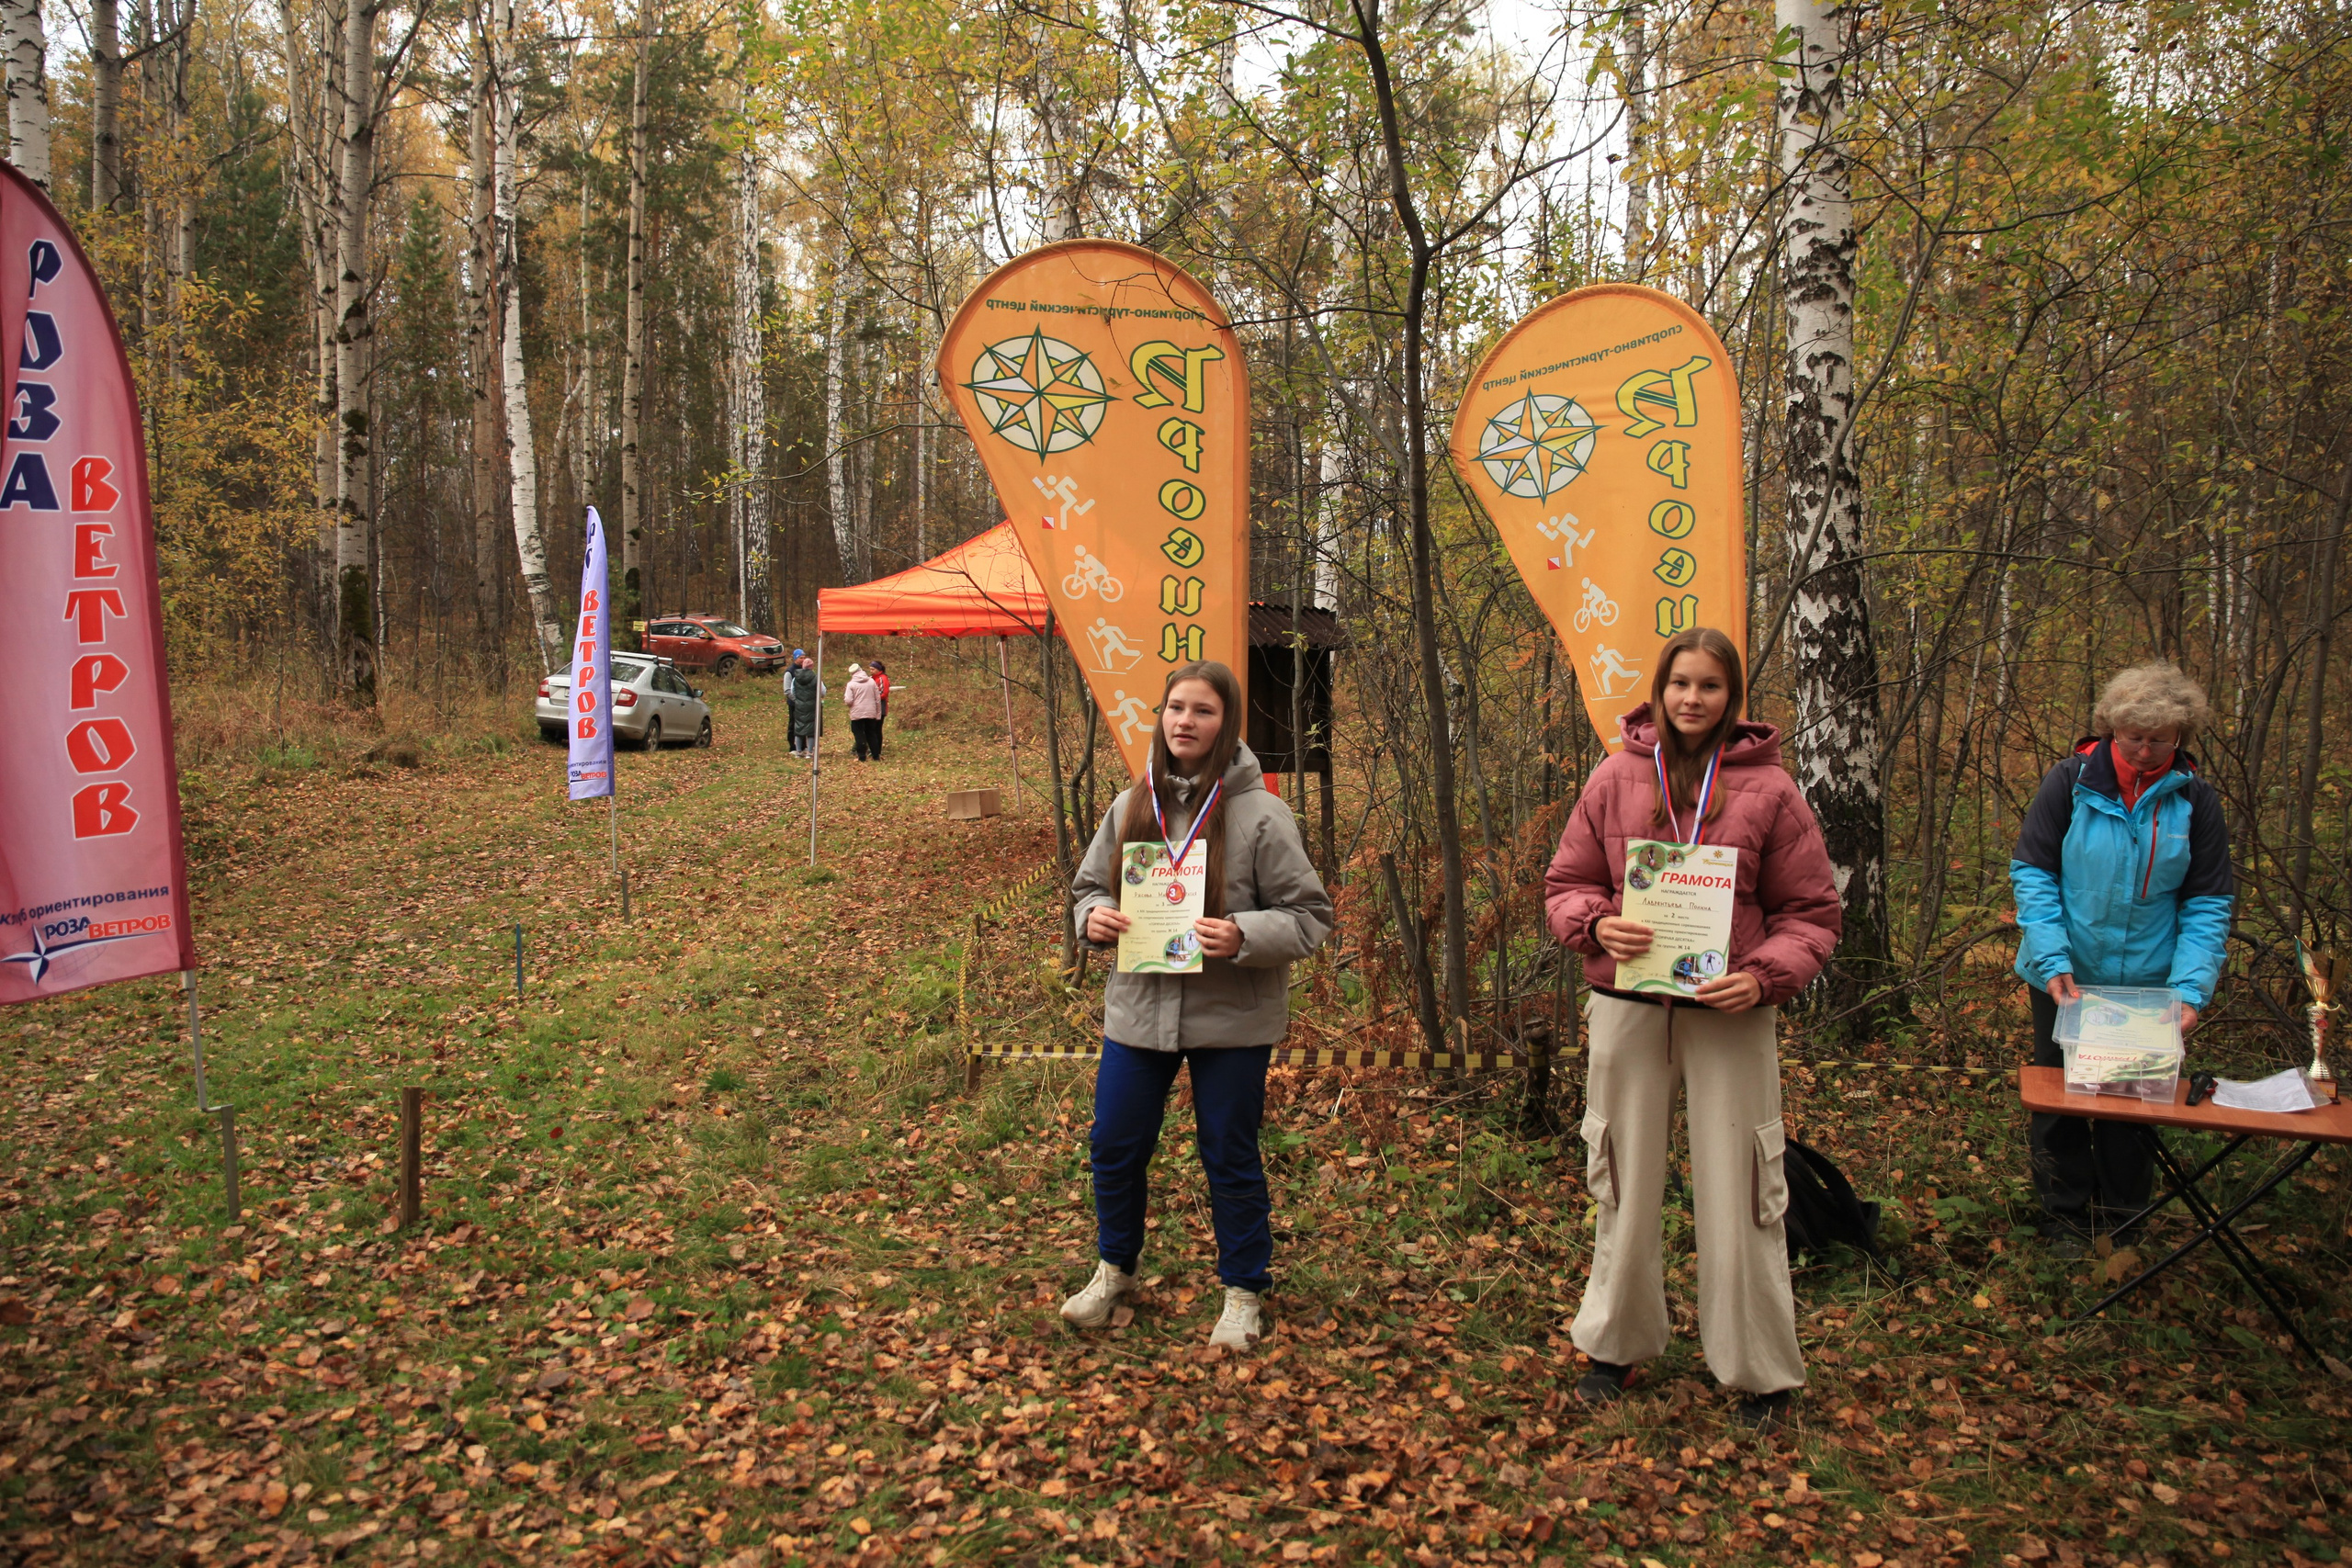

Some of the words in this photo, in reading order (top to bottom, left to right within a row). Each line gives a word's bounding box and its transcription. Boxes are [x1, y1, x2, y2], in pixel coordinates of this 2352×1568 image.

[63, 456, 141, 840] ВЕТРОВ
[577, 588, 600, 739] ВЕТРОВ
[581, 771, 607, 780] ВЕТРОВ
[1660, 872, 1732, 889] ГРАМОТА
[28, 886, 169, 919] ориентирования
[1169, 887, 1176, 897] 3
[1660, 888, 1697, 897] НАГРАЖДАЕТСЯ
[45, 916, 92, 940] РОЗА
[88, 914, 172, 939] ВЕТРОВ
